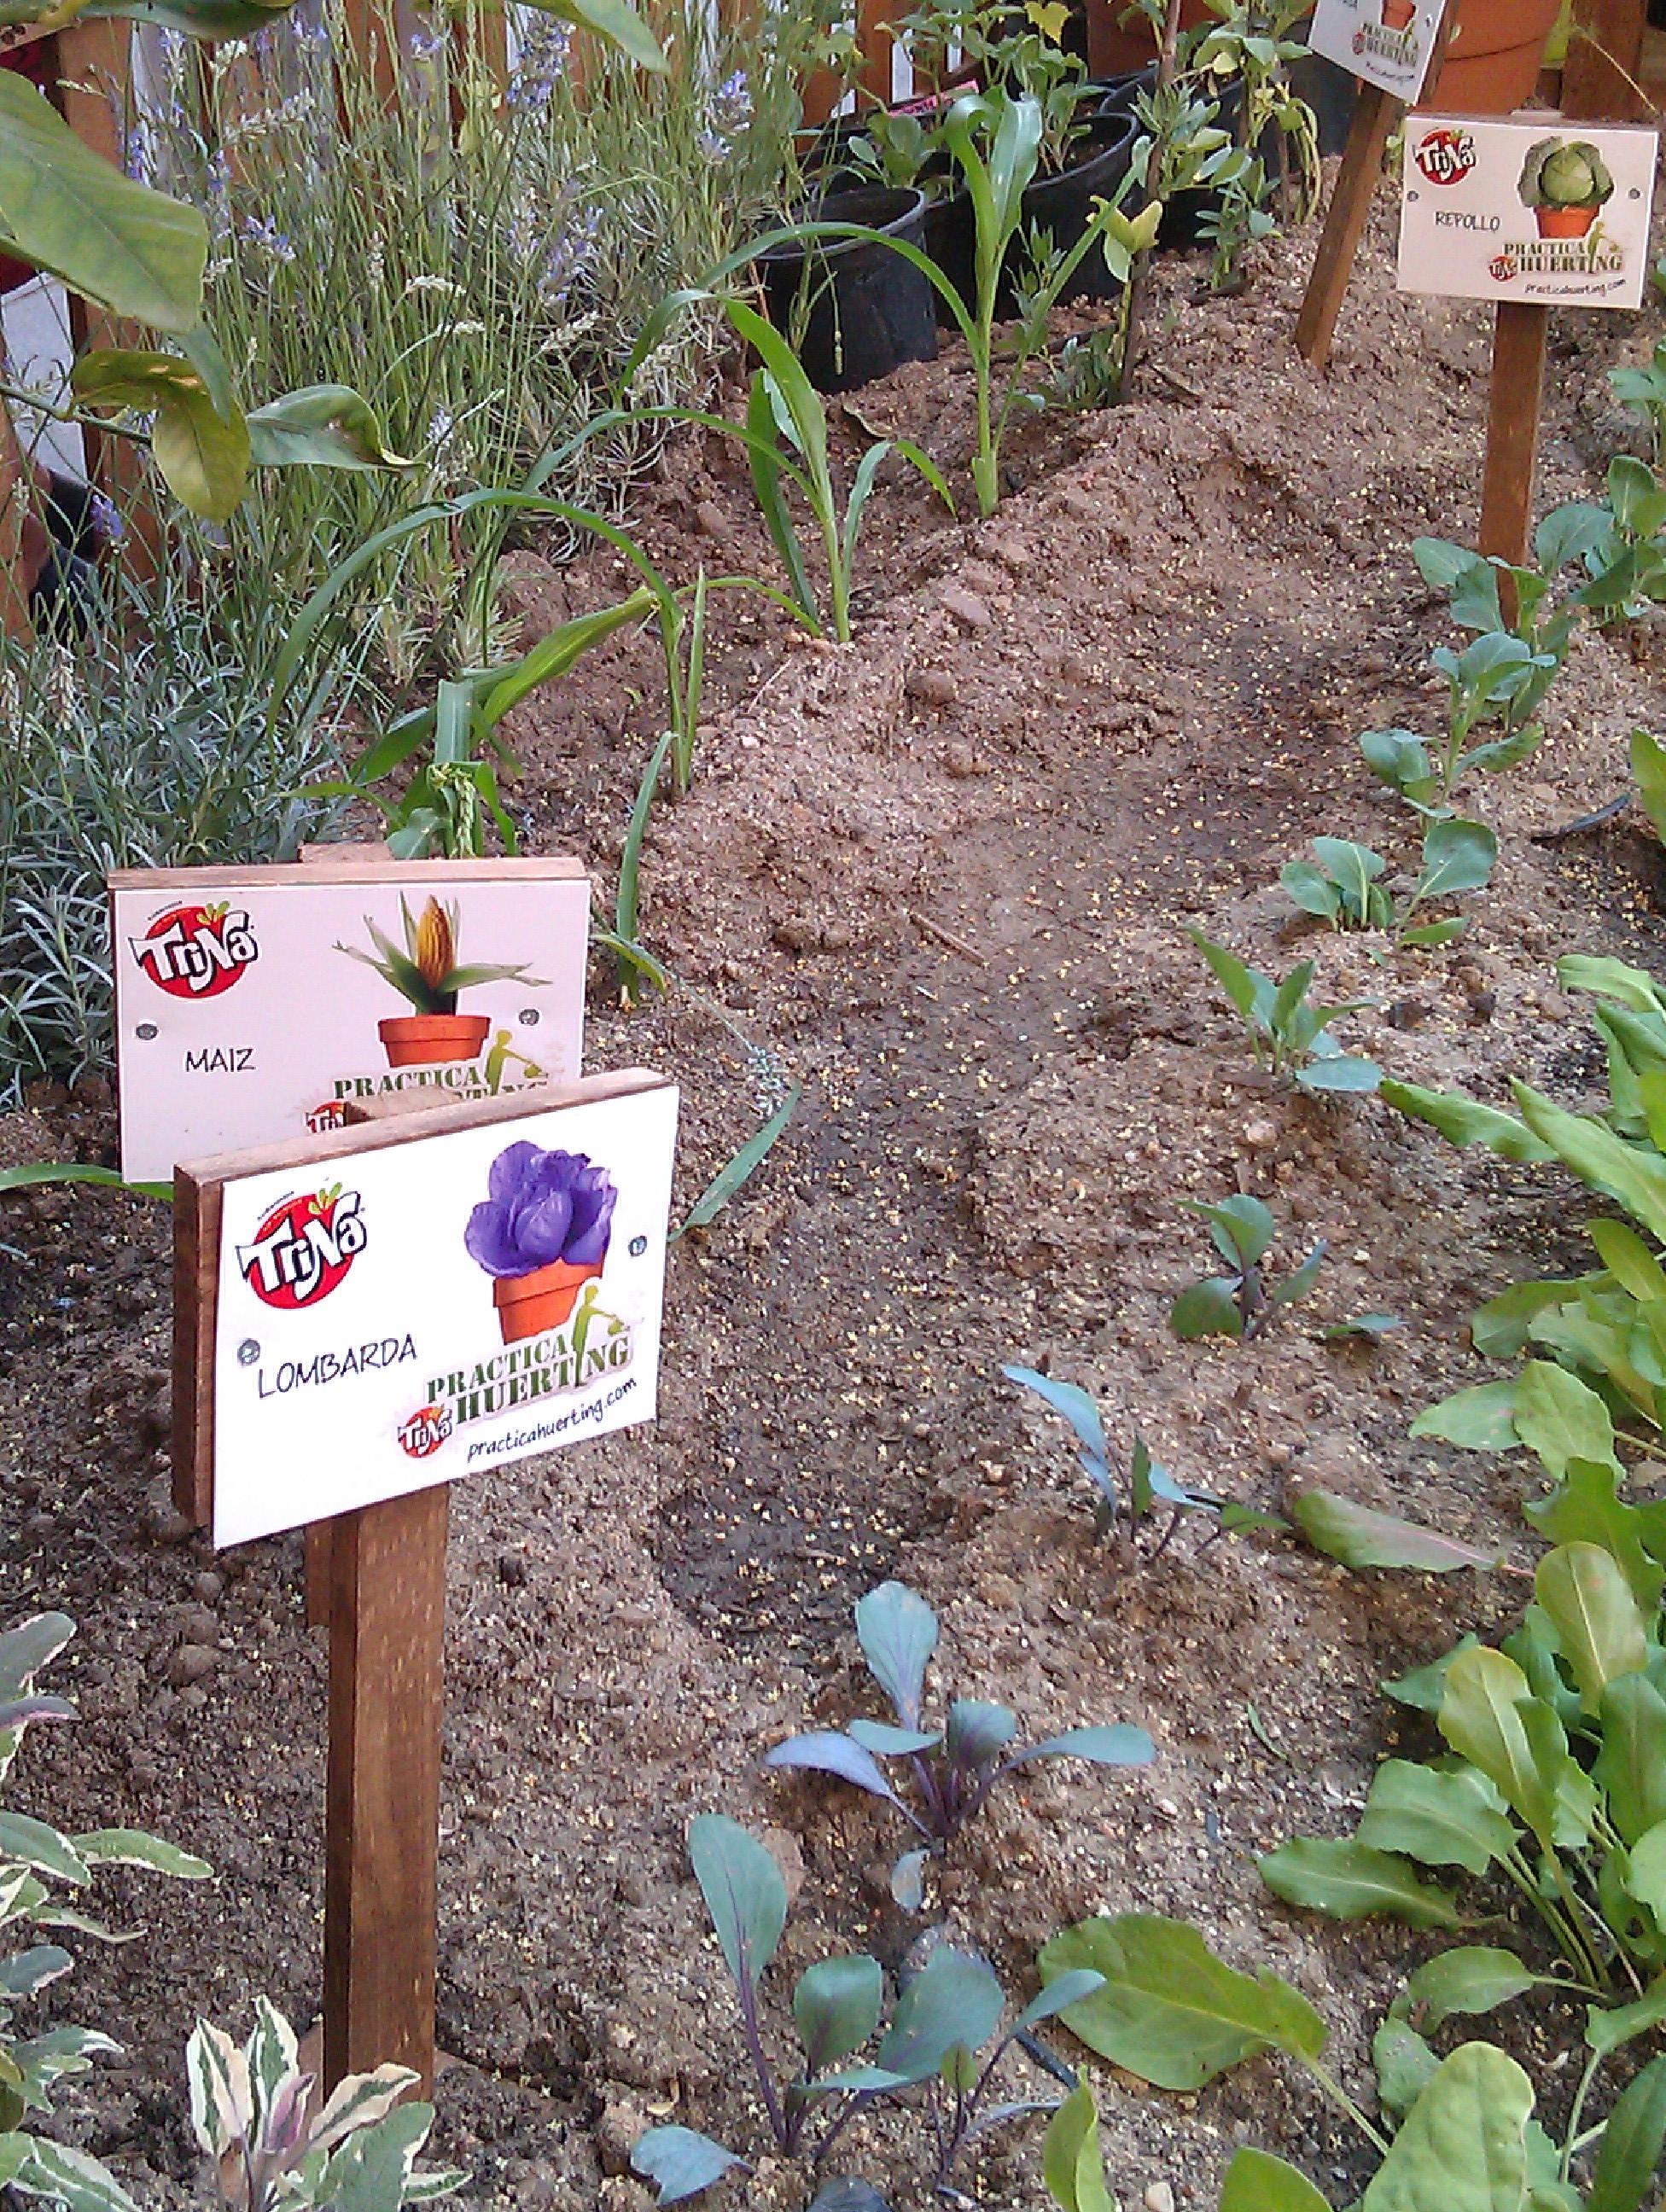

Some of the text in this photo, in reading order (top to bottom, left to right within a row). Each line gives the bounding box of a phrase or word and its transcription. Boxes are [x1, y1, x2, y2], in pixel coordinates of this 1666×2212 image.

[1435, 211, 1500, 232] REPOLLO
[184, 1047, 256, 1073] MAIZ
[334, 1065, 483, 1099] PRACTICA
[257, 1333, 418, 1400] LOMBARDA
[426, 1333, 569, 1404] PRACTICA
[455, 1334, 631, 1426] HUERTING
[466, 1376, 638, 1463] practicahuerting.com
